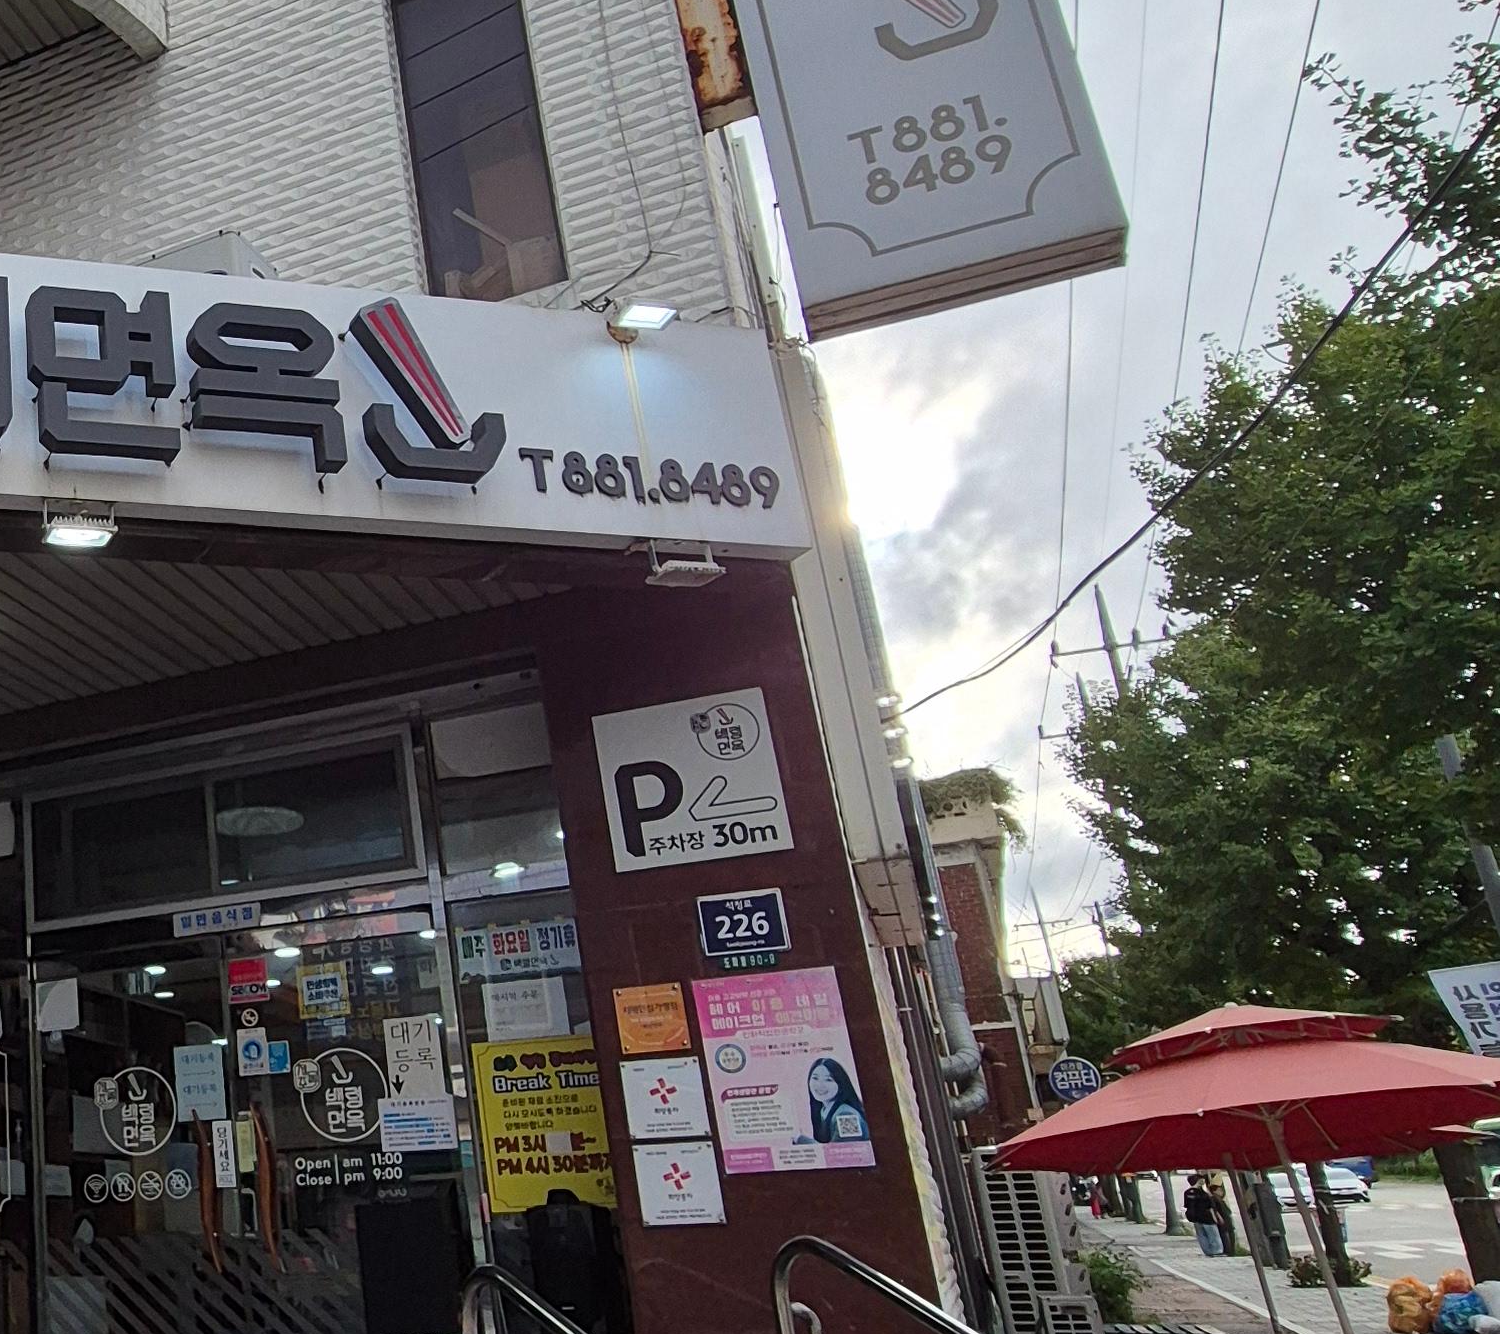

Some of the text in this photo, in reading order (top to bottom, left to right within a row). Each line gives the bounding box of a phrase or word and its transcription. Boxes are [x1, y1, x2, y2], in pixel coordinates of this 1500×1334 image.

[864, 133, 1013, 207] 8489
[614, 760, 684, 857] P
[648, 821, 779, 855] 주차장 30m
[725, 899, 753, 911] 석정로
[714, 911, 770, 939] 226
[461, 935, 486, 959] 매주
[492, 929, 531, 955] 화요일
[391, 1019, 432, 1045] 대기
[711, 1013, 766, 1030] 메이크업
[392, 1048, 437, 1073] 등록
[493, 1070, 600, 1093] Break Time
[1053, 1069, 1097, 1090] 컴퓨터
[504, 1110, 520, 1118] 다시
[555, 1104, 597, 1116] 하겠습니다
[216, 1126, 230, 1172] 당기세요
[494, 1137, 520, 1154] PM
[521, 1133, 547, 1153] 3시
[294, 1152, 403, 1173] Open am 11:00
[497, 1158, 523, 1175] PM
[525, 1155, 550, 1175] 4시
[295, 1166, 403, 1186] Close pm 9:00
